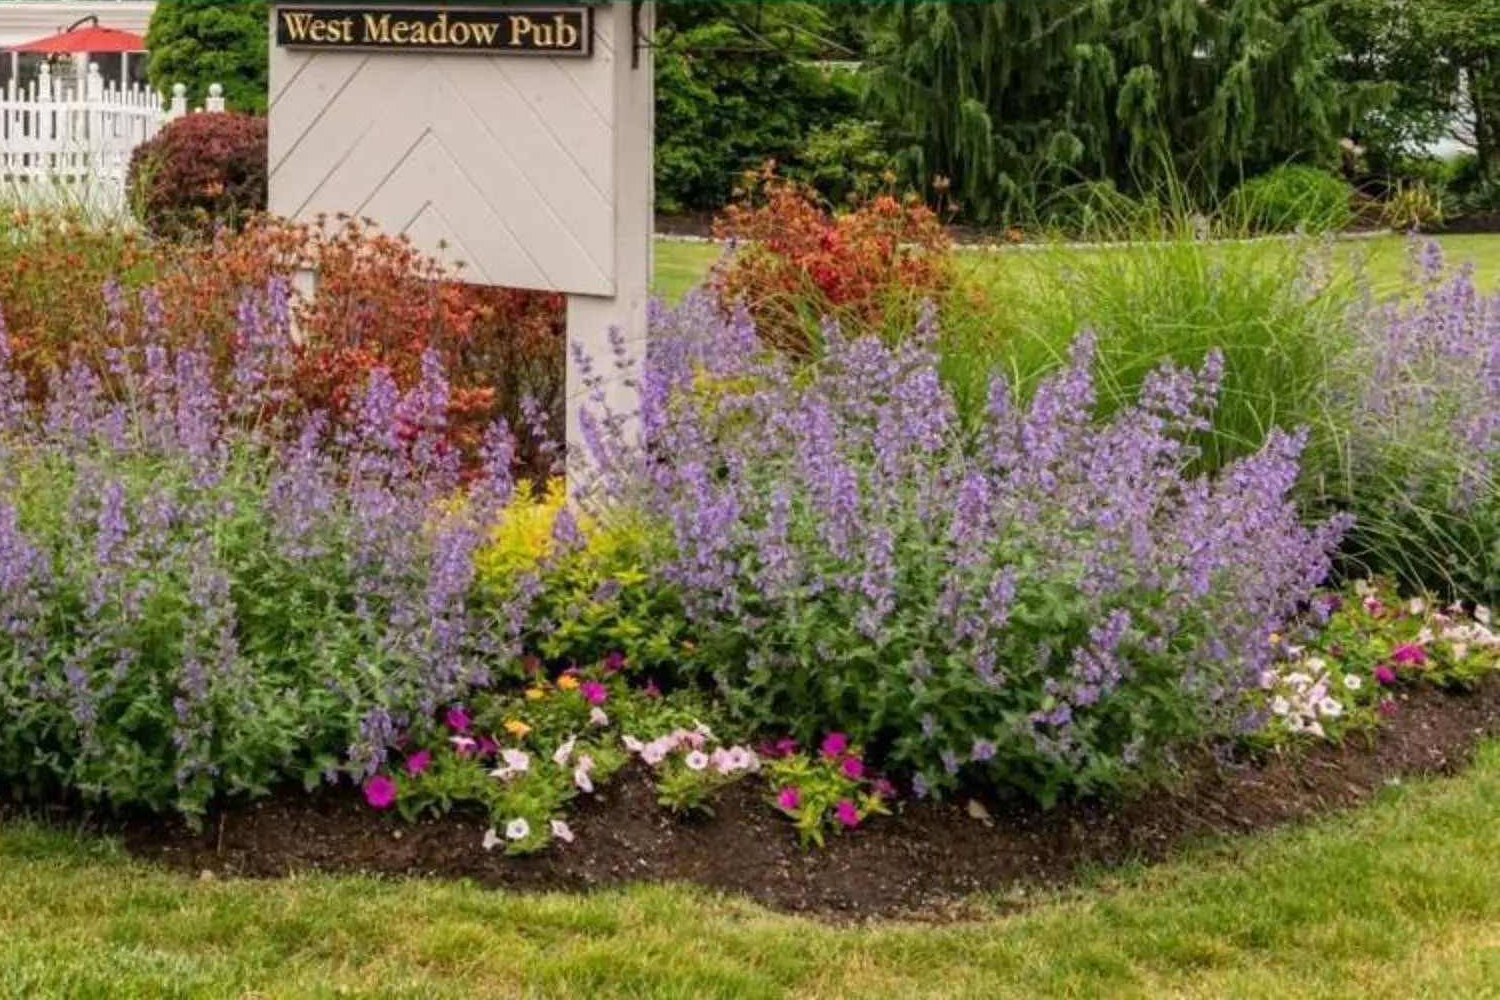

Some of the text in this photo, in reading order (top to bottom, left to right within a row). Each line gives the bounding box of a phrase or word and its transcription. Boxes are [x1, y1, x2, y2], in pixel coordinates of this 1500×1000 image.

[283, 12, 577, 48] West Meadow Pub
